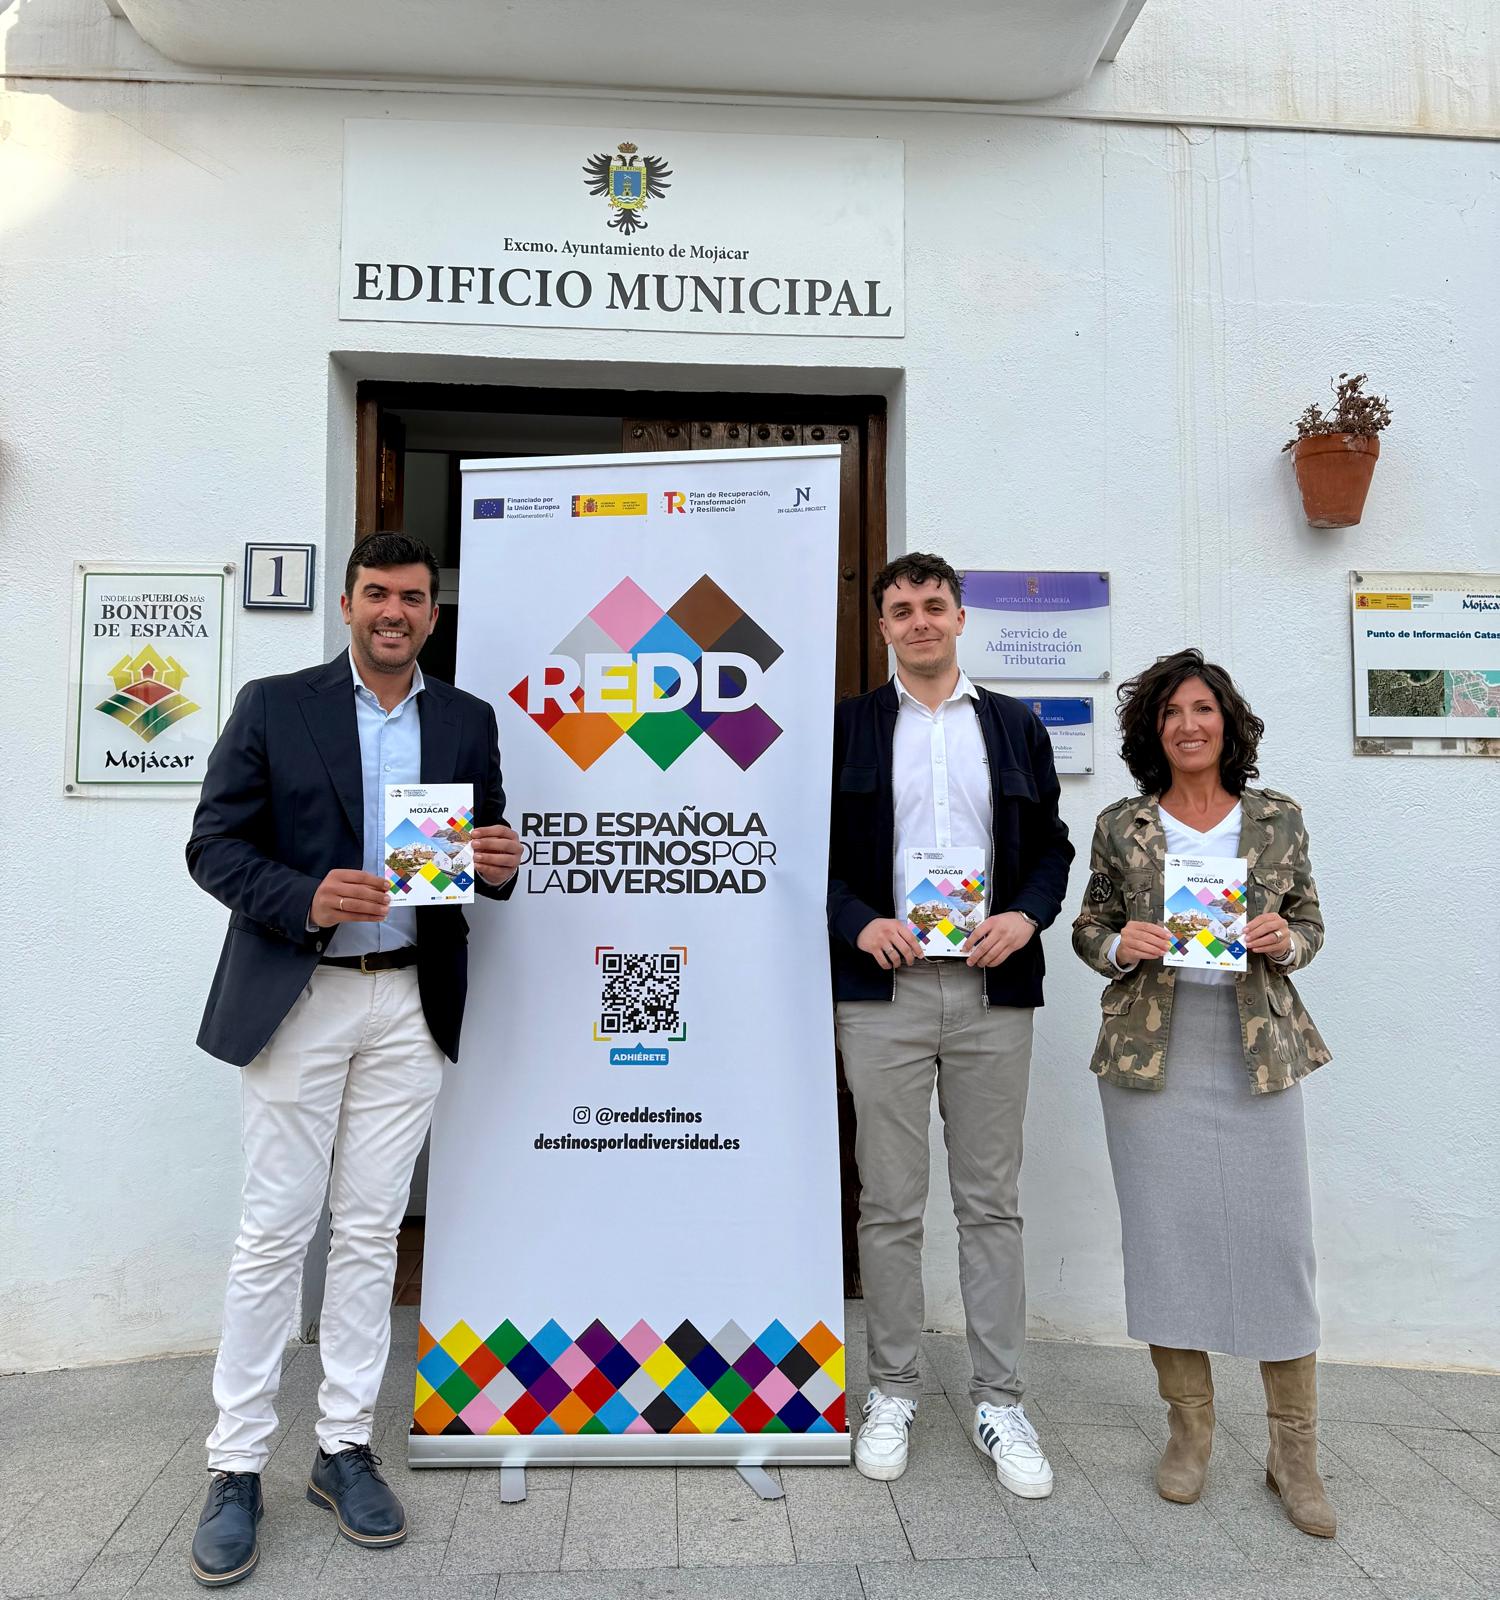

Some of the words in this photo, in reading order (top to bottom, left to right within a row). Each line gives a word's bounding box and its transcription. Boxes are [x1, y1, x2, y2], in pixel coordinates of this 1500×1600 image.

[503, 237, 558, 254] Excmo.
[561, 240, 665, 259] Ayuntamiento
[668, 243, 687, 258] de
[690, 245, 749, 262] Mojácar
[353, 263, 593, 309] EDIFICIO
[605, 272, 892, 318] MUNICIPAL
[718, 490, 771, 499] Recuperación,
[141, 594, 189, 602] PUEBLOS
[101, 604, 203, 620] BONITOS
[1462, 599, 1500, 612] Mojáca
[93, 623, 120, 638] DE
[130, 620, 209, 638] ESPAÑA
[1000, 628, 1049, 639] Servicio
[1053, 628, 1067, 639] de
[1367, 630, 1395, 638] Punto
[1398, 630, 1410, 638] de
[1413, 630, 1471, 639] Información
[986, 641, 1082, 653] Administración
[1003, 654, 1066, 665] Tributaria
[527, 651, 767, 714] REDD
[105, 750, 194, 773] Mojácar
[410, 806, 449, 814] MOJÁCAR
[521, 812, 588, 837] RED
[596, 806, 768, 837] ESPAÑOLA
[1187, 876, 1224, 885] MOJÁCAR
[613, 1051, 666, 1061] ADHIÉRETE
[595, 1107, 702, 1125] @reddestinos
[534, 1133, 740, 1152] destinosporladiversidad.es
